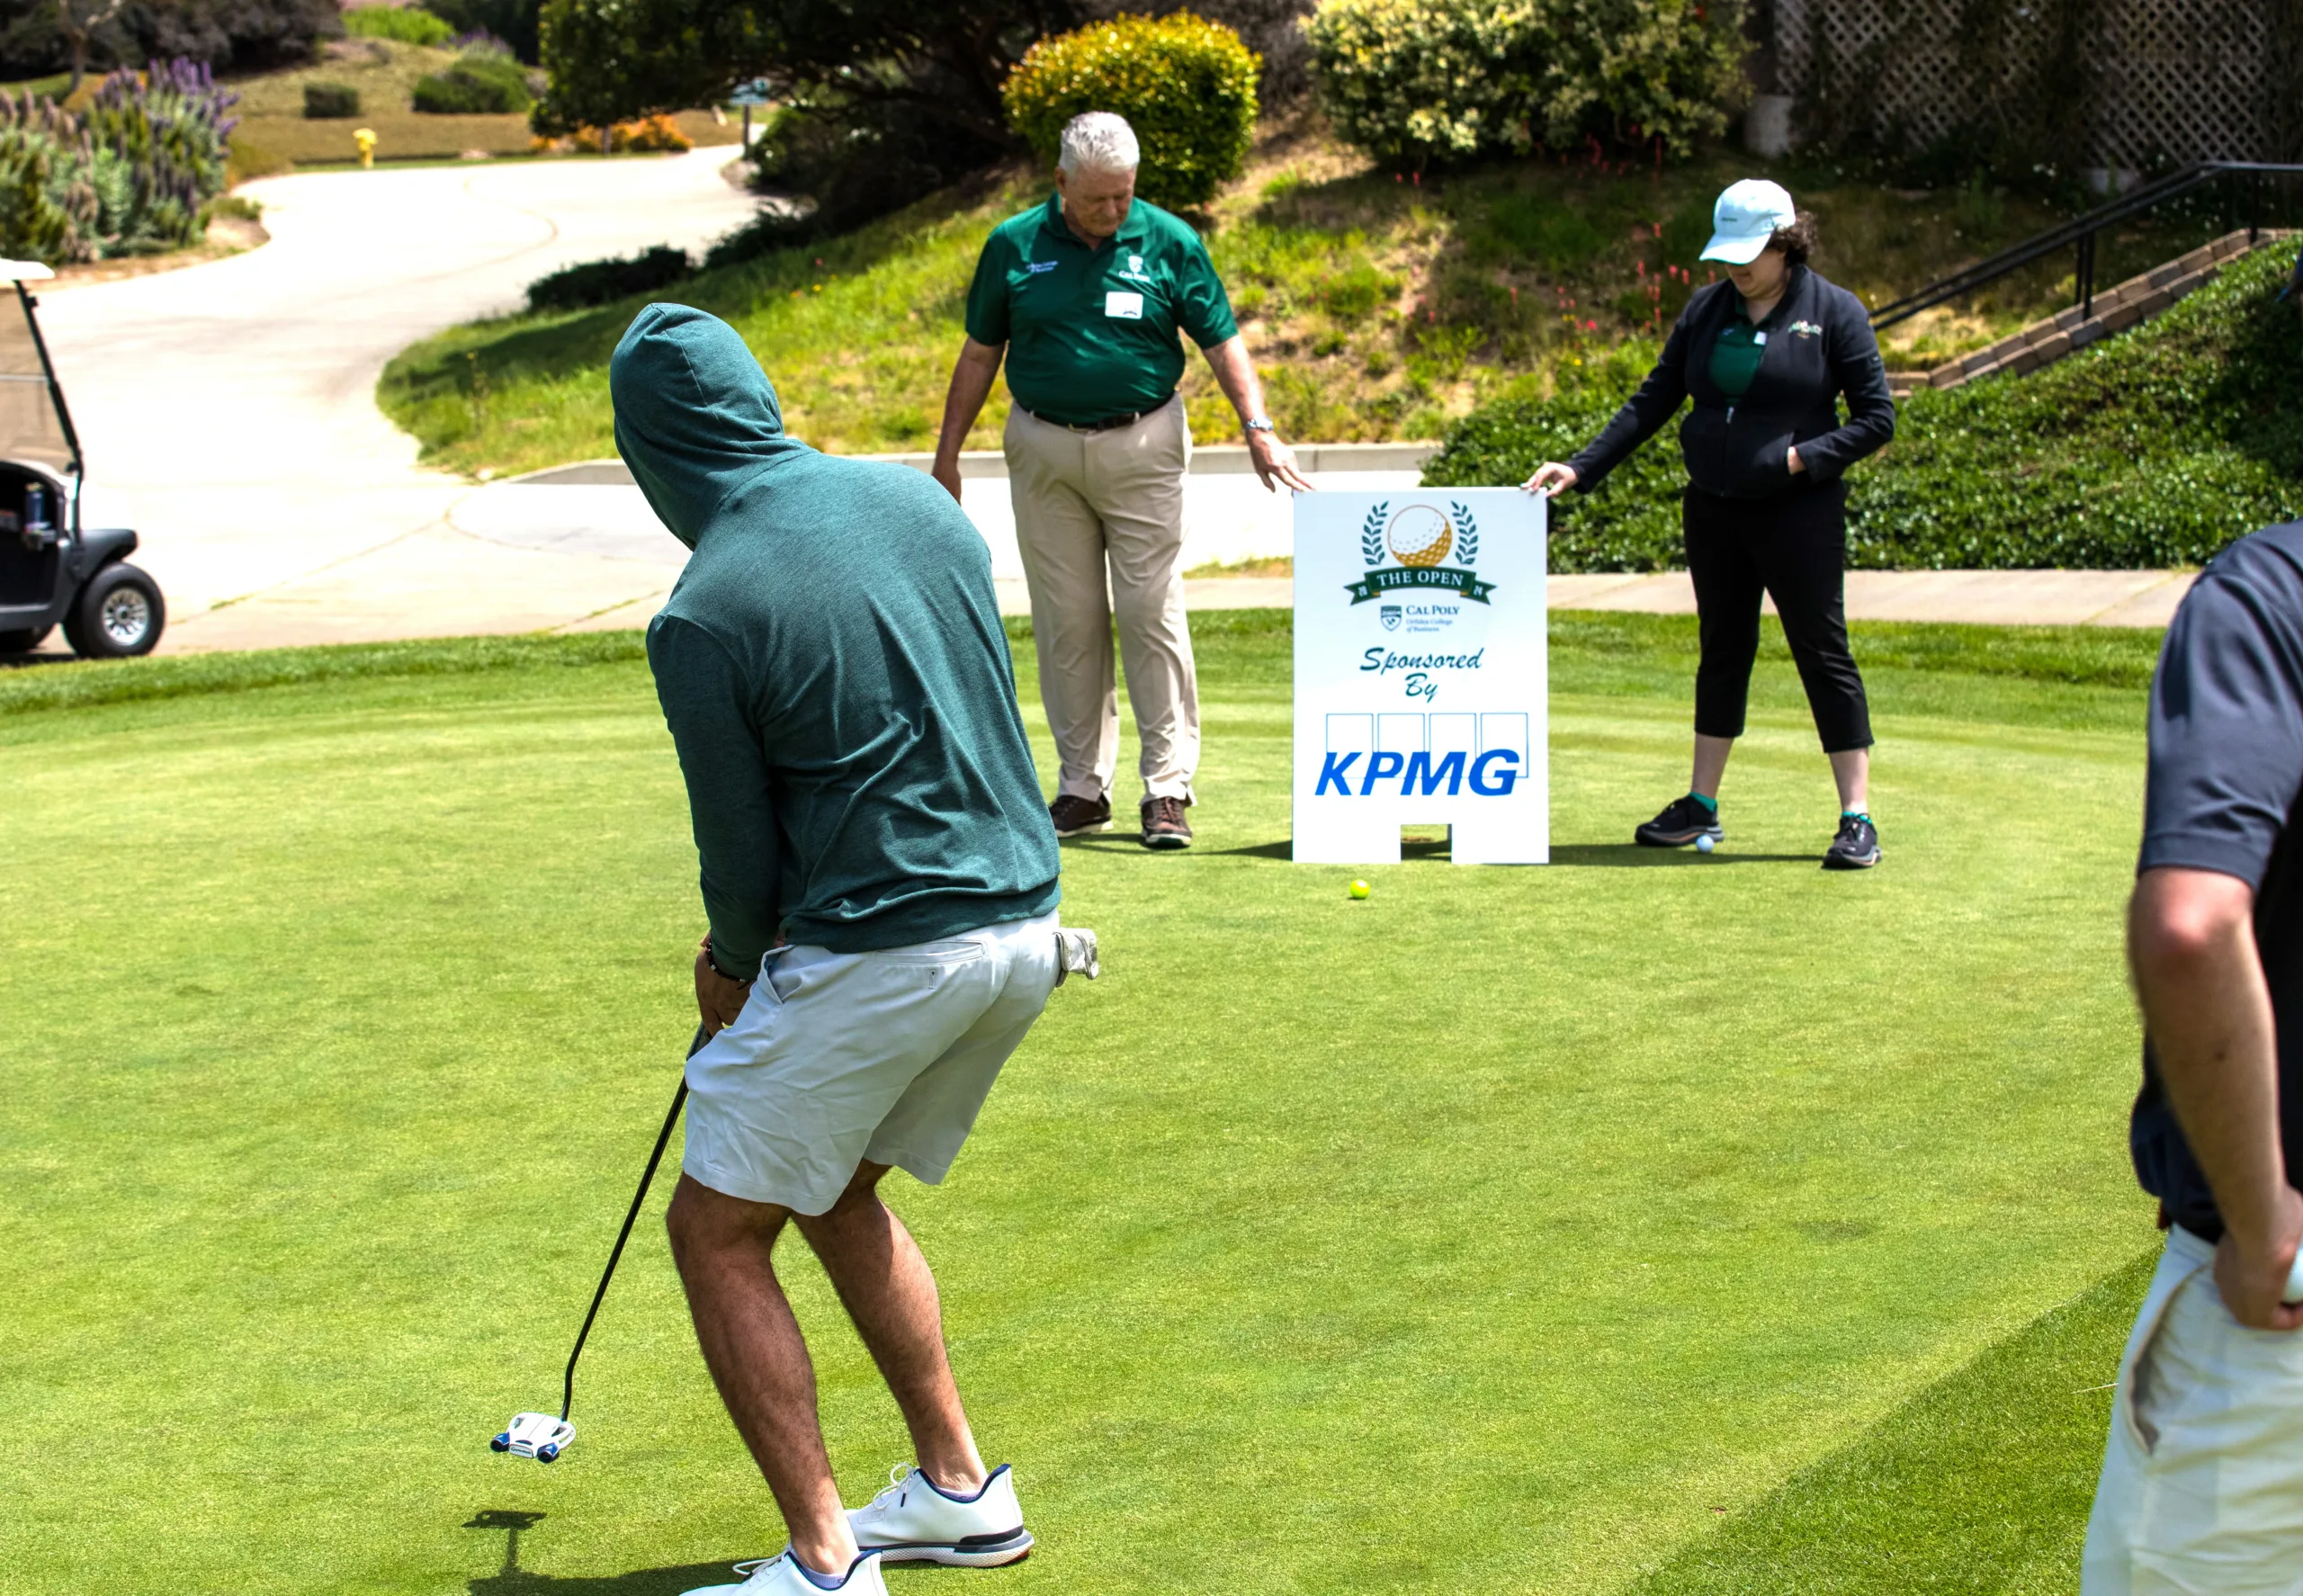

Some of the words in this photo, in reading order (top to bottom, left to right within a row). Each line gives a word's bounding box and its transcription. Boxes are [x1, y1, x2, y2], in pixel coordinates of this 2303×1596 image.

[1376, 571, 1412, 587] THE
[1417, 570, 1465, 587] OPEN
[1359, 647, 1484, 675] Sponsored
[1405, 673, 1438, 703] By
[1314, 749, 1519, 796] KPMG
